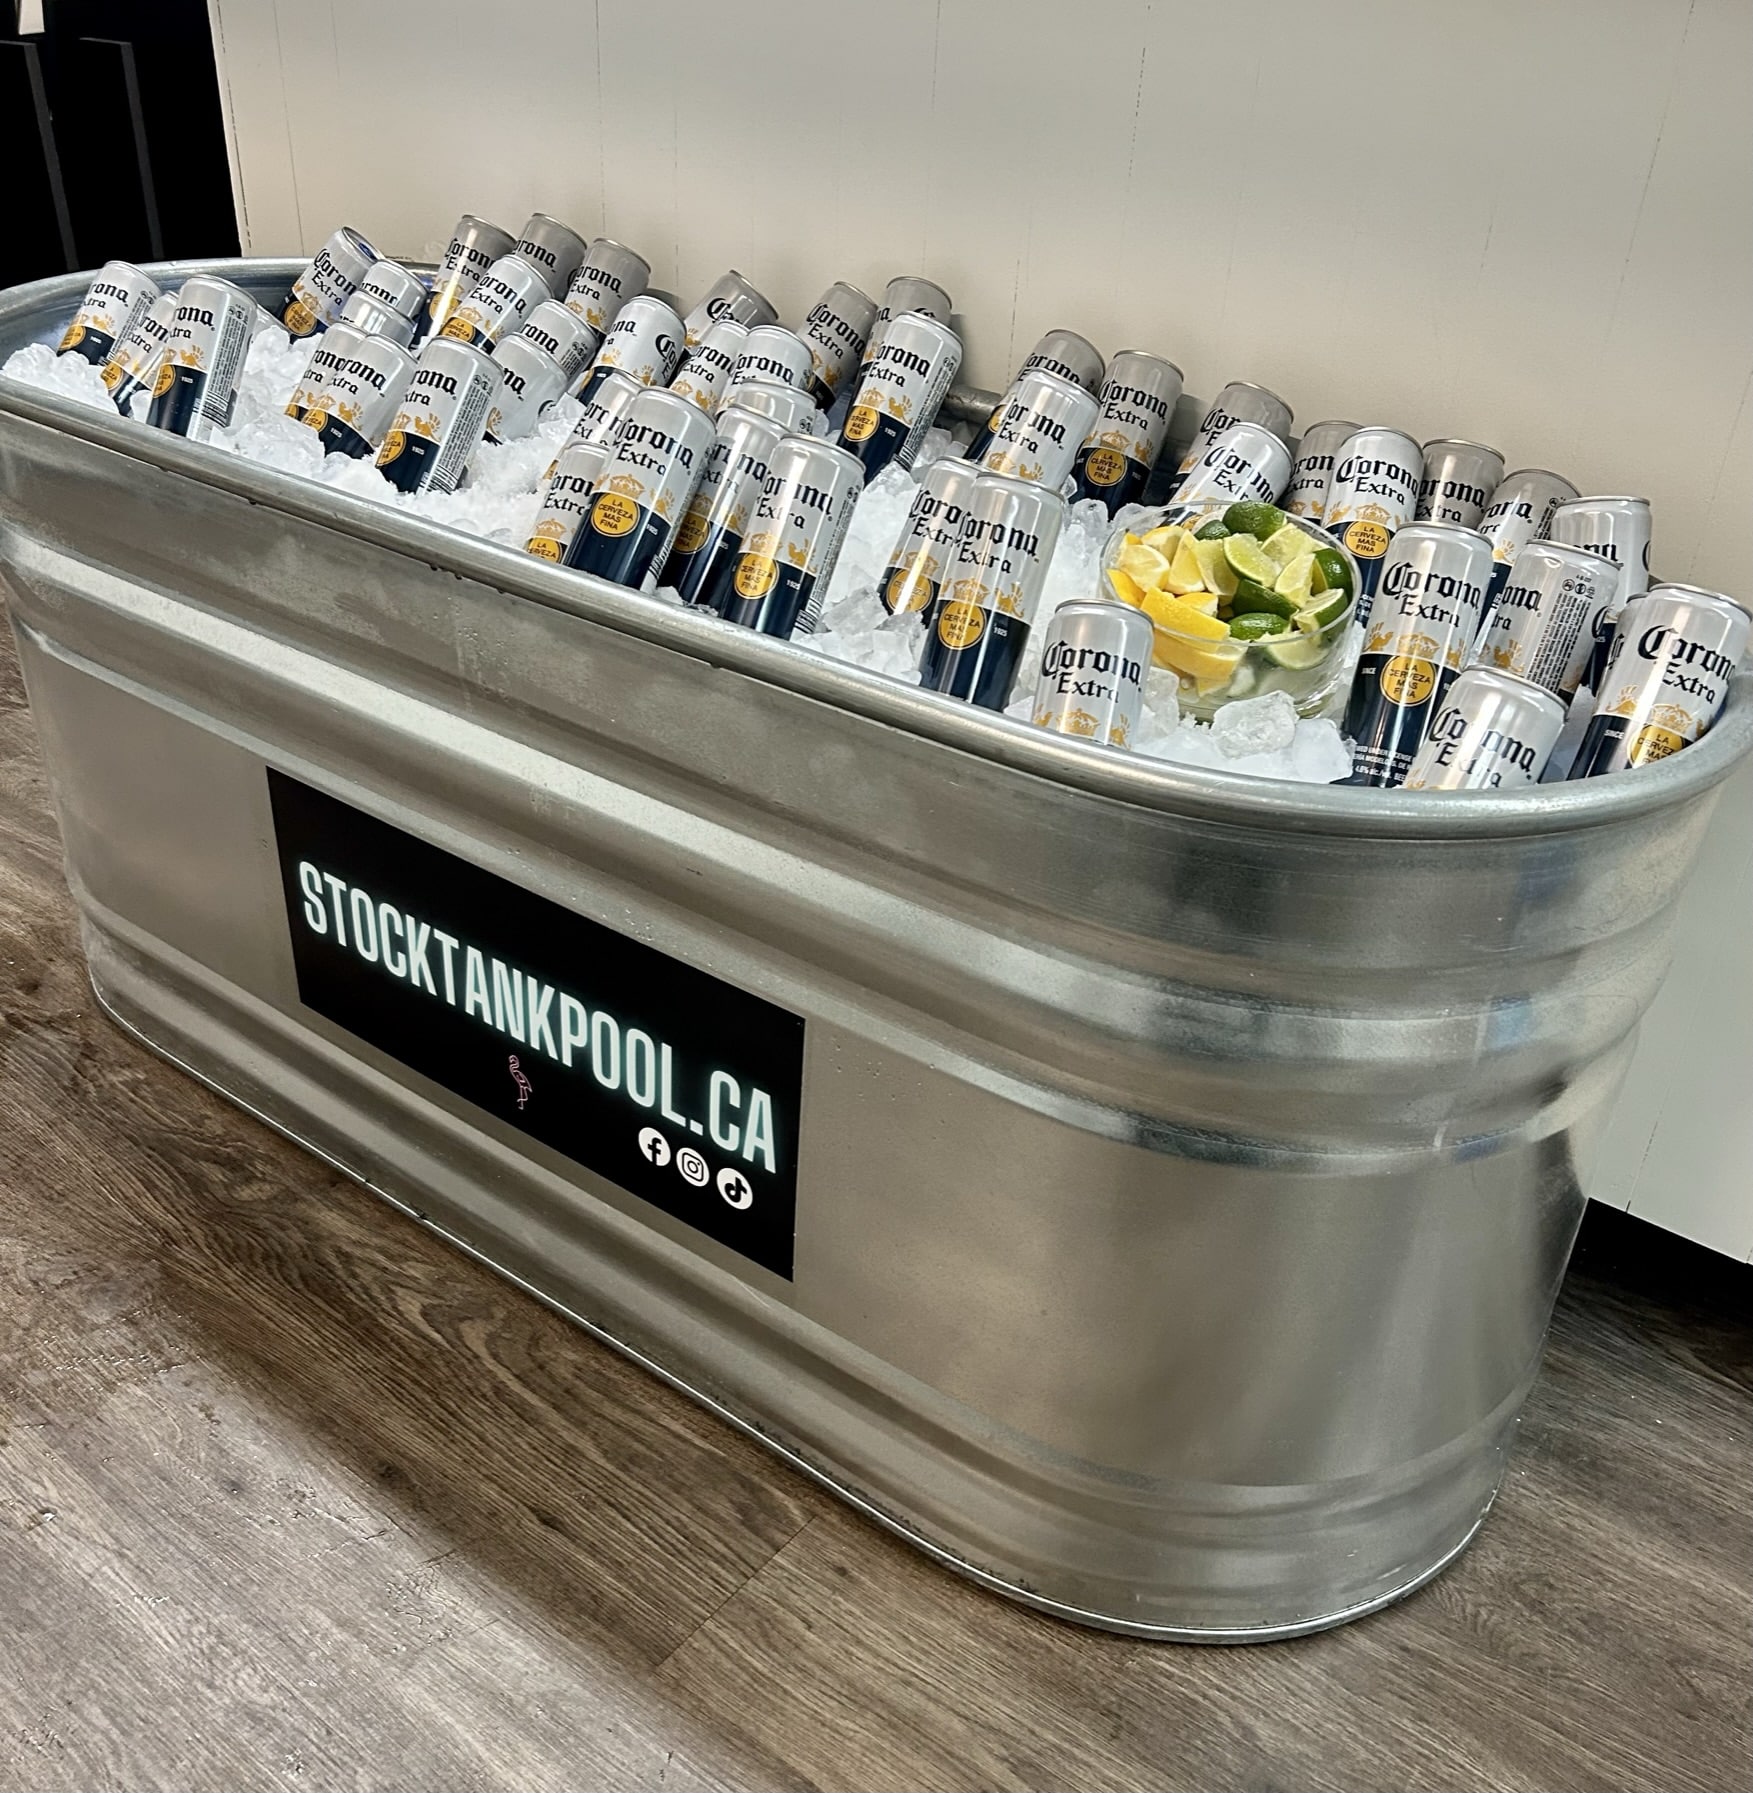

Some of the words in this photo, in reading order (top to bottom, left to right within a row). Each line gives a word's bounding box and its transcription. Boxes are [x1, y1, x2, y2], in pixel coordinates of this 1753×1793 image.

[314, 248, 357, 296] Coron
[311, 269, 343, 306] Extra
[128, 332, 152, 353] xtra
[520, 323, 559, 355] rona
[808, 324, 844, 359] Extra
[869, 361, 906, 387] Extra
[1103, 401, 1149, 431] Extra
[617, 442, 667, 477] Extra
[1094, 471, 1110, 480] FINA
[1336, 455, 1421, 500] Corona
[612, 499, 623, 508] LA
[909, 488, 963, 524] Coro
[1355, 477, 1405, 506] Extra
[598, 504, 633, 520] CERVEZA
[600, 520, 618, 530] FINA
[602, 512, 621, 523] MAS
[1349, 530, 1386, 544] CERVEZA
[1355, 544, 1375, 553] FINA
[1357, 538, 1376, 547] MAS
[1381, 561, 1480, 610] Corona
[1041, 640, 1142, 686] Corona
[1405, 663, 1418, 672] LA
[1053, 671, 1120, 703] Extra
[1662, 661, 1716, 705] Extra
[1603, 729, 1625, 740] SINCE
[1656, 734, 1669, 744] LA
[299, 860, 777, 1176] STOCKTANKPOOL.CA
